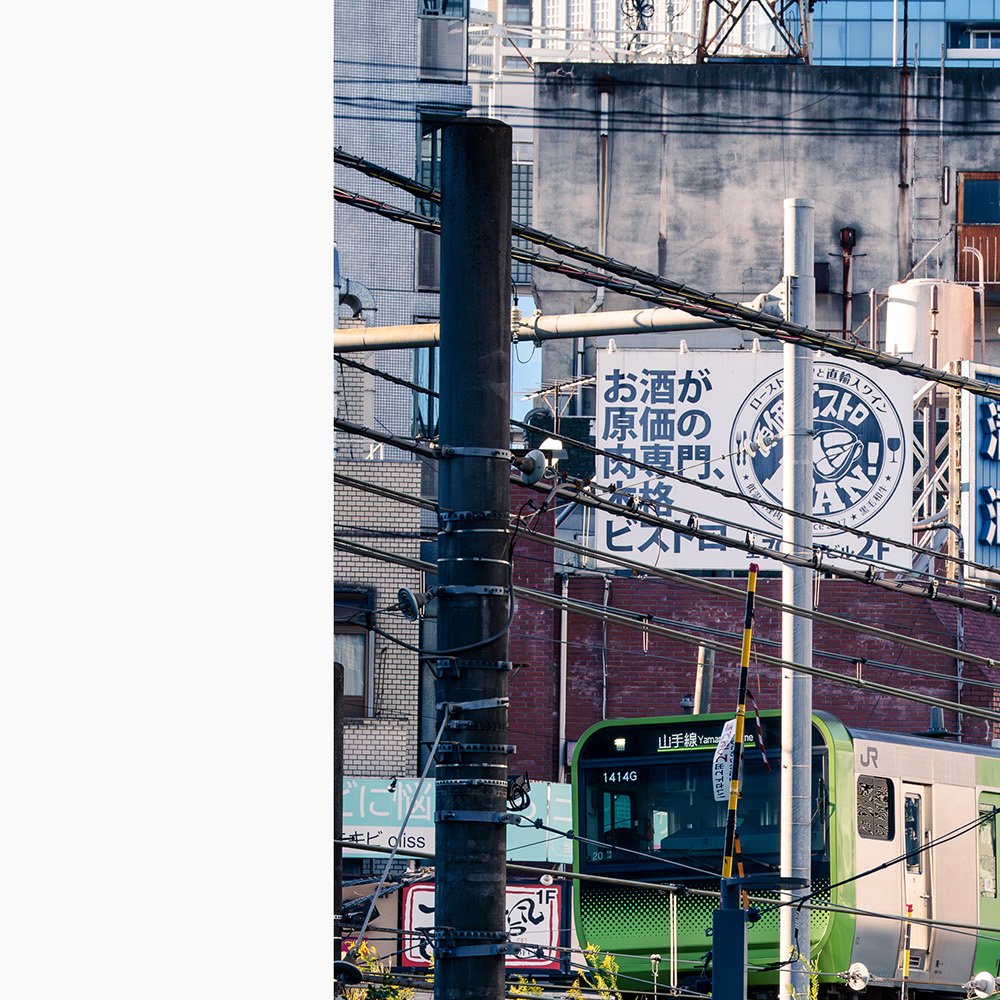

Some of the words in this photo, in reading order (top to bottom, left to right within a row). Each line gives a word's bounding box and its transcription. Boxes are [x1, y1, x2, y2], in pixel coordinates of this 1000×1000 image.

[604, 368, 713, 404] お酒が
[602, 406, 712, 442] 原価の
[658, 732, 698, 749] 山手線
[860, 746, 879, 769] JR
[603, 770, 638, 783] 1414G
[536, 889, 557, 905] 1F
